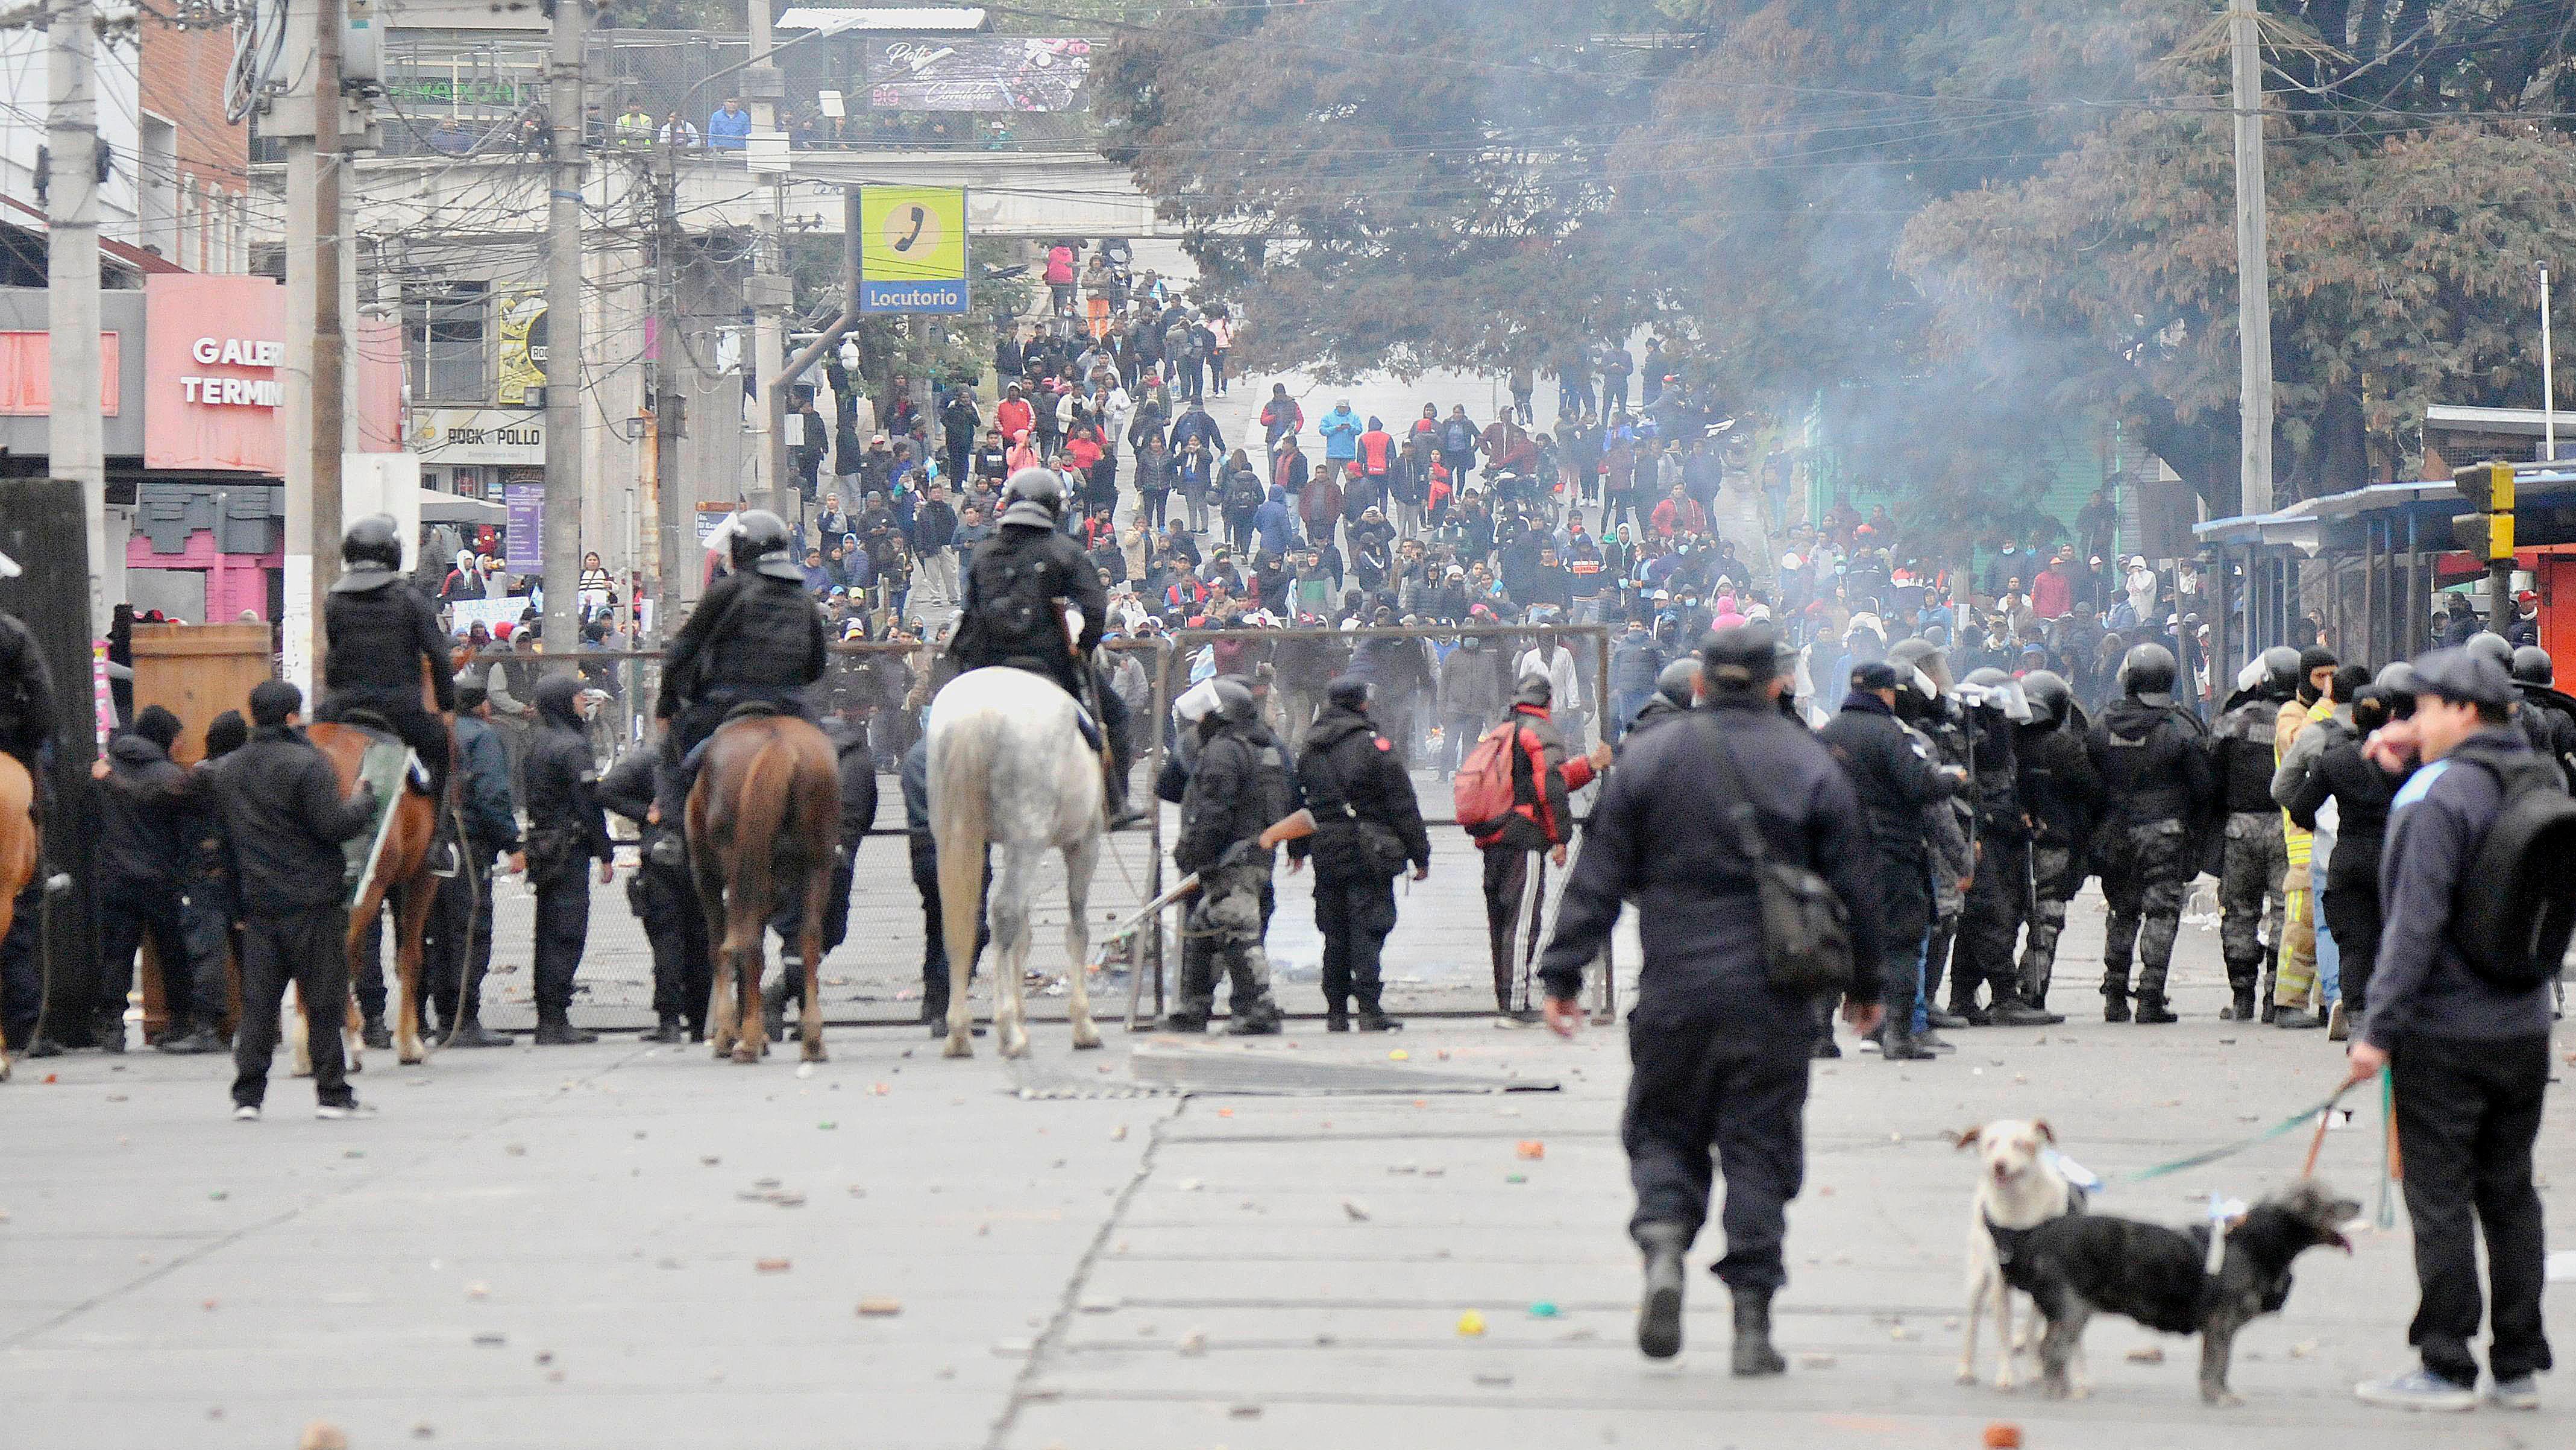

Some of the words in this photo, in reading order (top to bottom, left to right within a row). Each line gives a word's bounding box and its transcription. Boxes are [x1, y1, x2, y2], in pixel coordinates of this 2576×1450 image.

[886, 42, 934, 65] Pat
[870, 288, 958, 306] Locutorio
[448, 429, 485, 445] ROCK
[498, 429, 539, 446] POLLO
